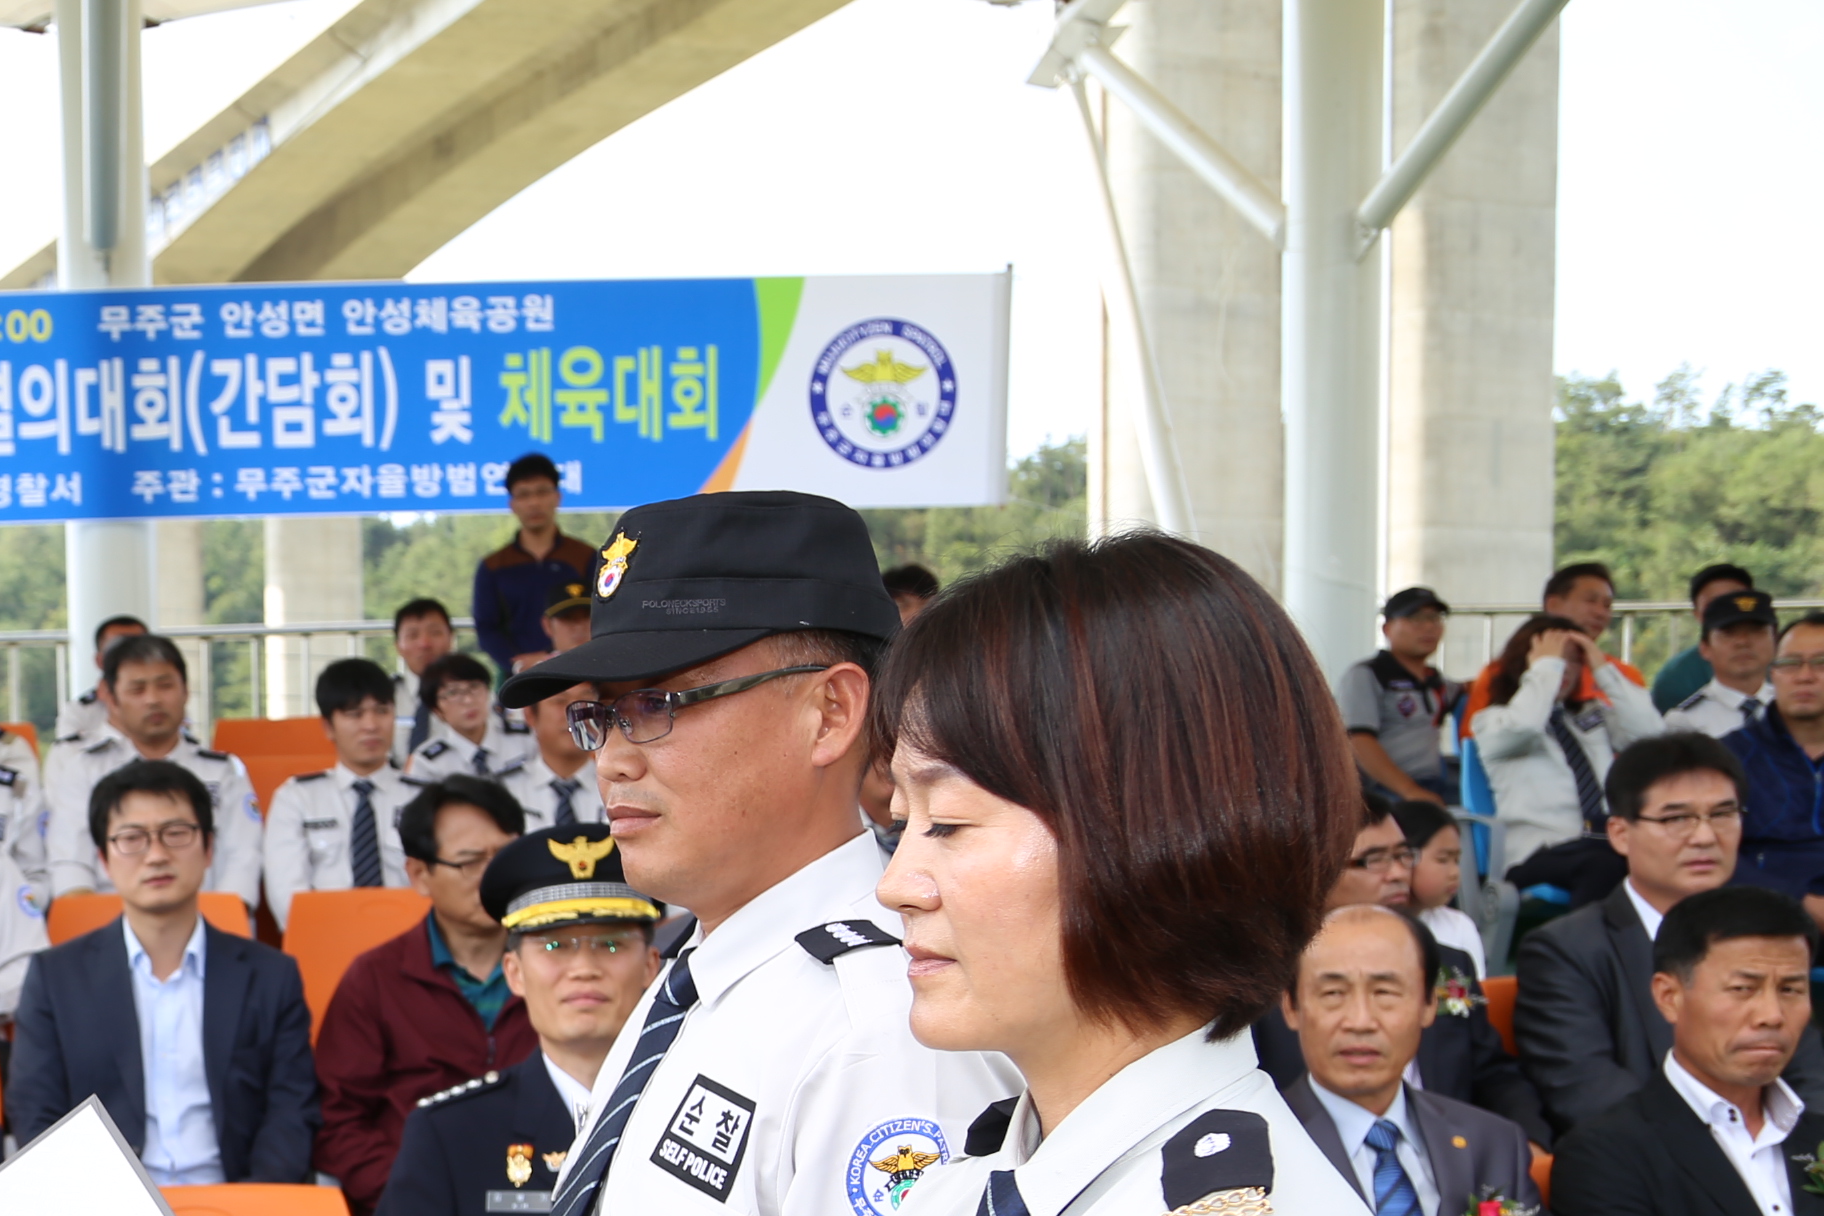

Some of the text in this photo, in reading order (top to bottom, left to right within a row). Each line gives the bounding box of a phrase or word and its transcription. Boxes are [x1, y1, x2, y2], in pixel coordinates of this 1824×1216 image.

[97, 303, 205, 342] 무주군
[219, 299, 325, 338] 안성면
[341, 294, 554, 336] 안성체육공원
[425, 354, 474, 445] 및
[497, 343, 719, 444] 체육대회
[131, 468, 201, 504] 주관
[234, 460, 583, 502] 무주군자율방범연대
[679, 1095, 740, 1154] 순찰
[659, 1138, 728, 1190] SELF POLICE
[850, 1120, 949, 1185] KOREA CITIZEN'S PATR
